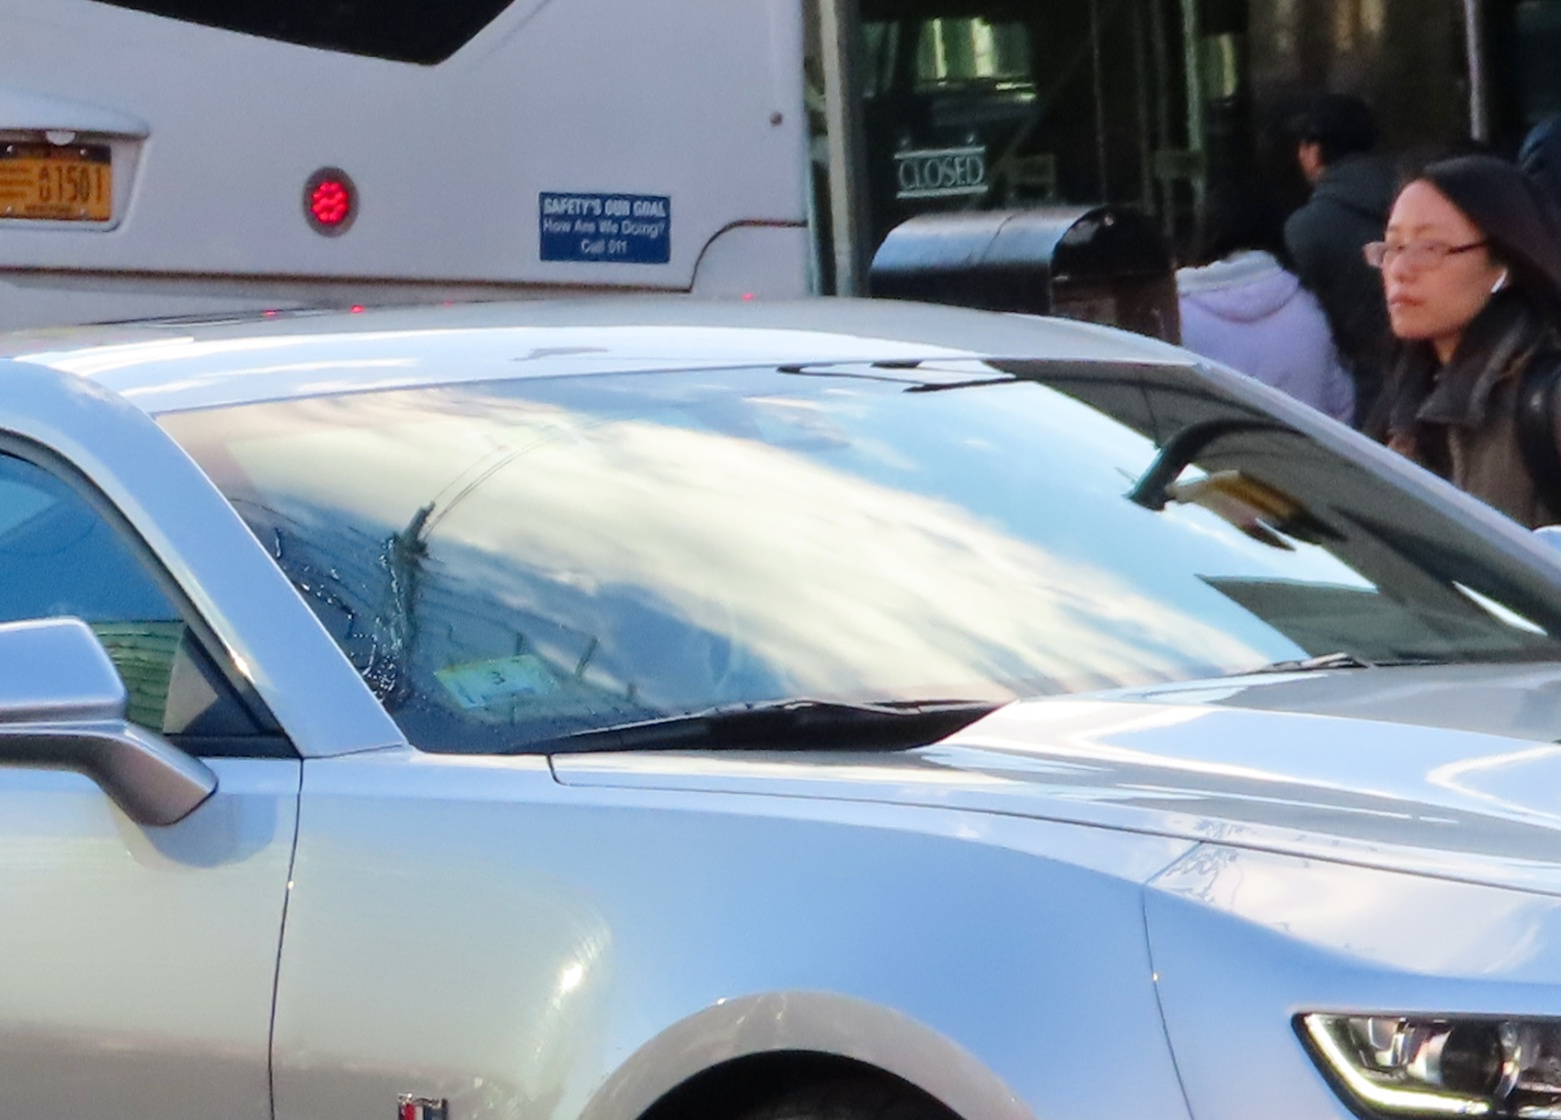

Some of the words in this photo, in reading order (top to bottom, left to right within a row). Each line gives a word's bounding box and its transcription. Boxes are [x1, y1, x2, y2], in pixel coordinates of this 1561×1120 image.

[899, 155, 985, 191] CLOSED
[543, 198, 602, 216] SAFETY'S
[604, 198, 631, 217] OUR
[633, 200, 666, 218] GOAL
[543, 218, 572, 233] How
[574, 219, 597, 234] Are
[599, 219, 620, 234] We
[581, 239, 605, 253] Call
